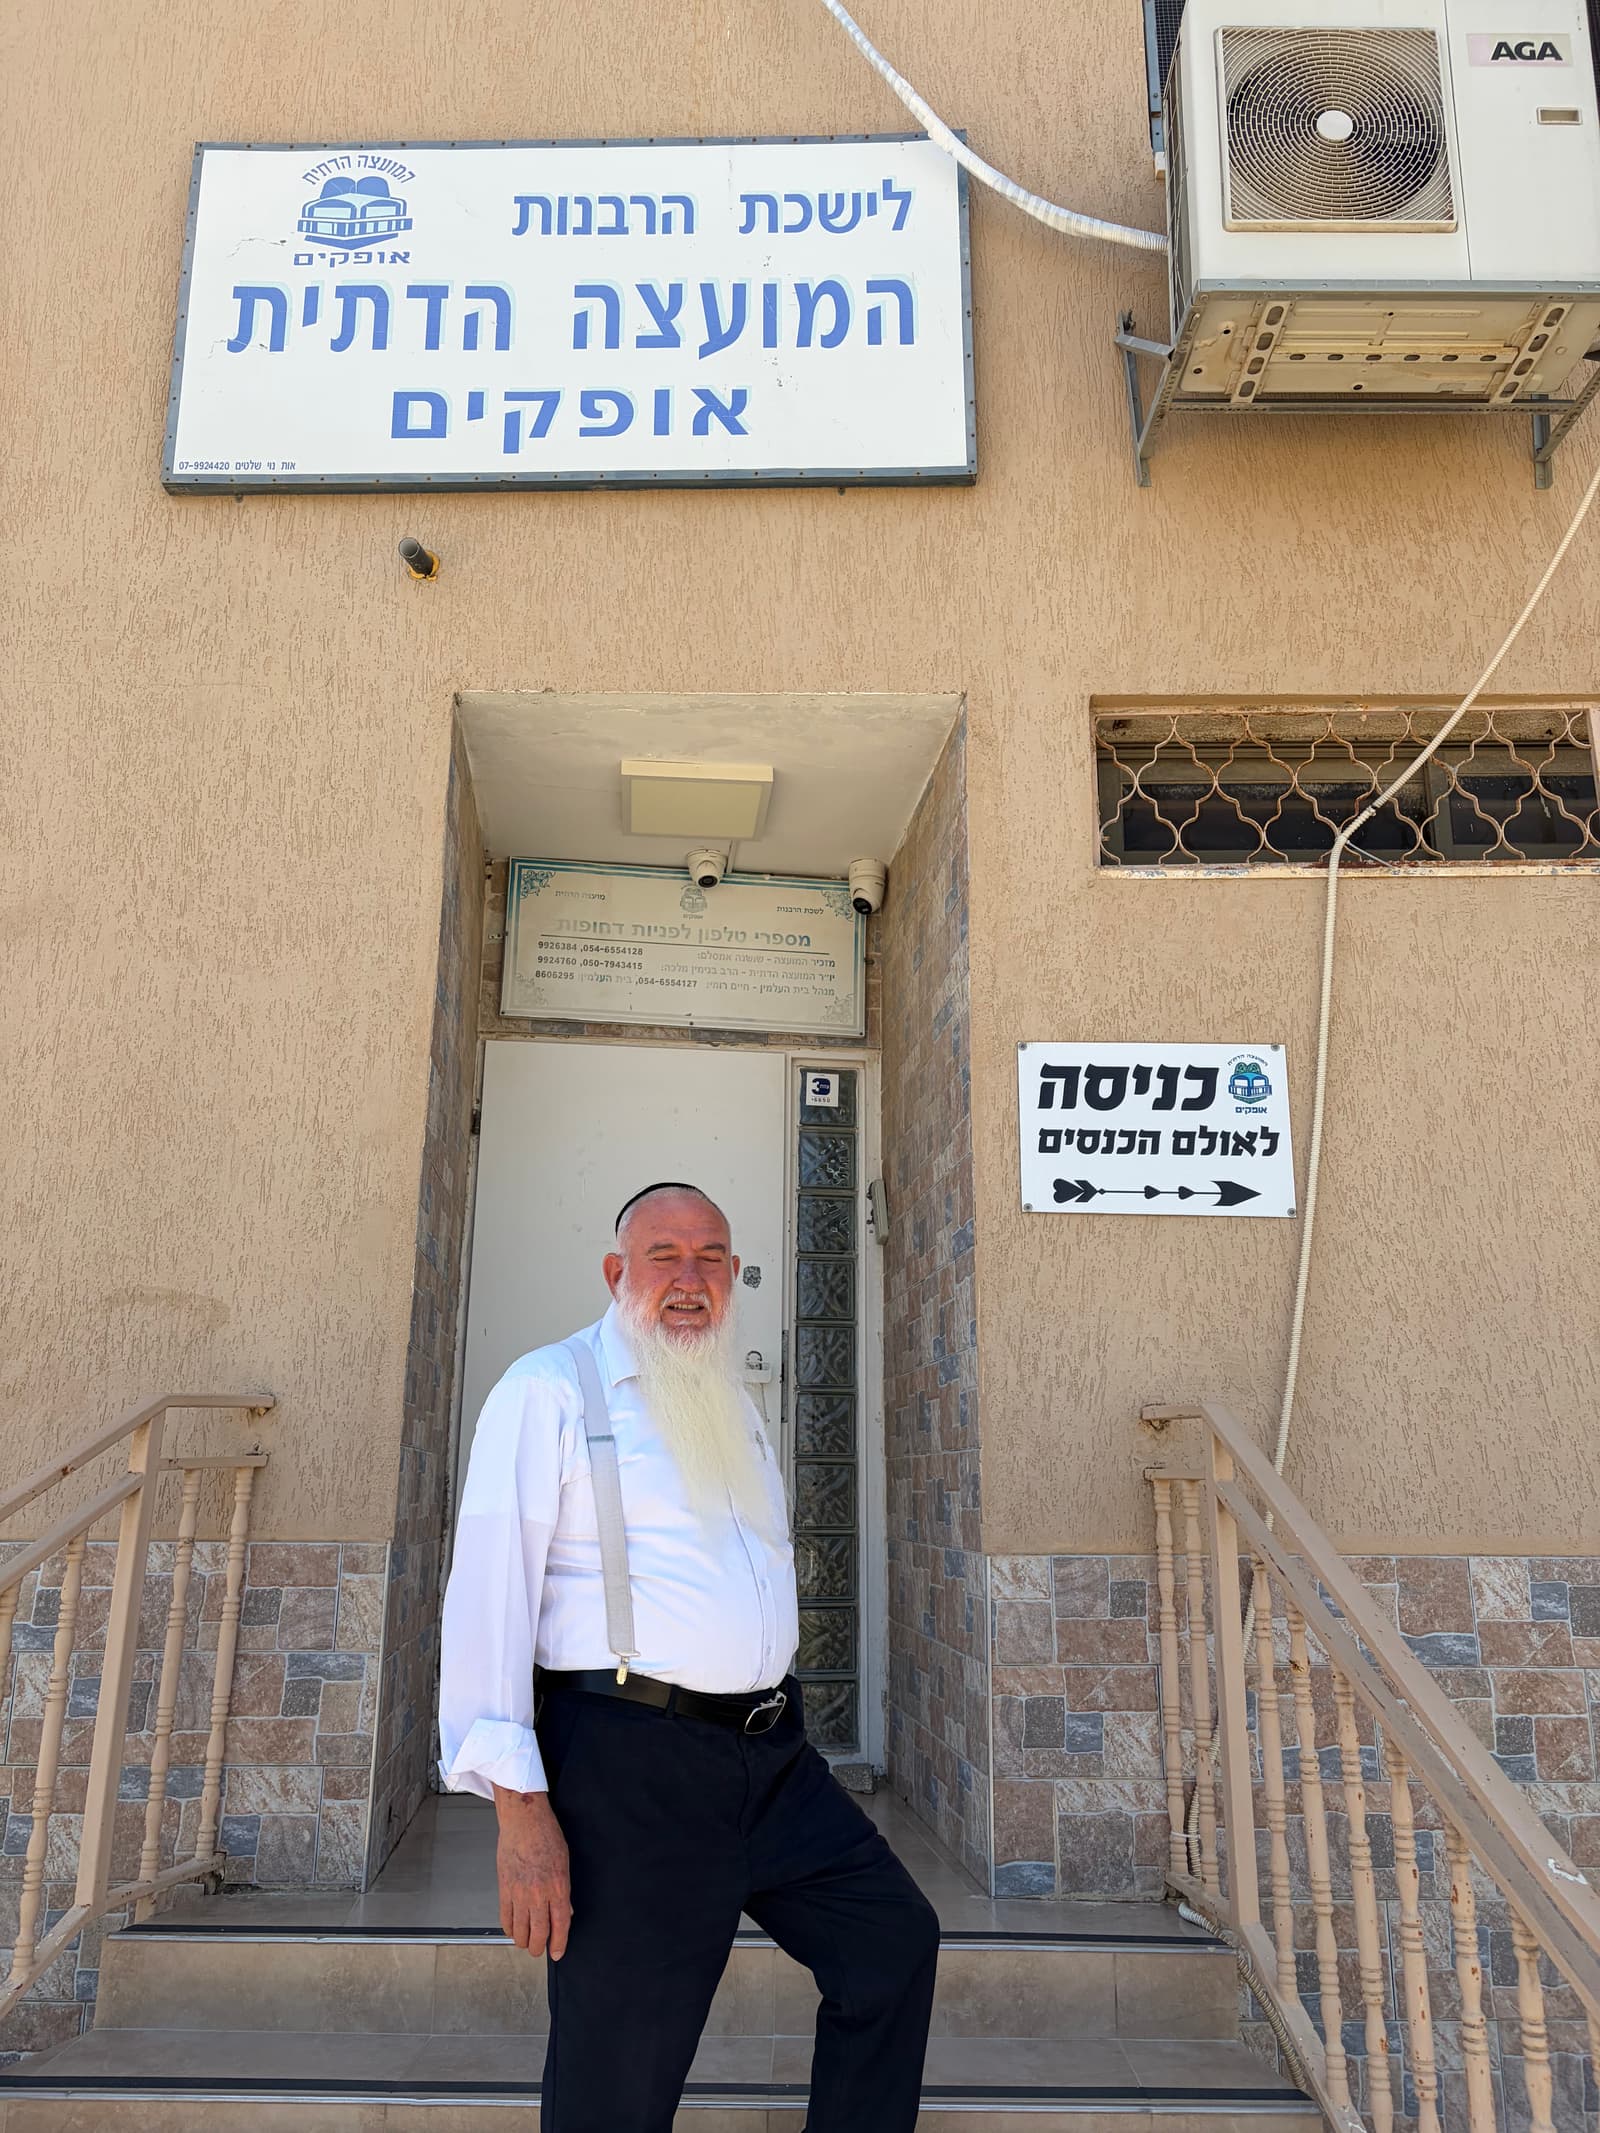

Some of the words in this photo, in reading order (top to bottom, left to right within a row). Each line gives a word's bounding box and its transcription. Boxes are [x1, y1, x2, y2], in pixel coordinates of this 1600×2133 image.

[1491, 41, 1563, 61] AGA
[302, 156, 352, 185] הדתית
[358, 155, 416, 183] המועצה
[512, 194, 696, 236] הרבנות
[739, 179, 913, 234] לישכת
[293, 251, 411, 268] אופקים
[227, 284, 512, 353] הדתית
[573, 279, 916, 360] המועצה
[390, 387, 750, 454] אופקים
[179, 461, 230, 471] 07-9924420
[235, 460, 262, 471] שלטים
[281, 461, 296, 471] אות
[556, 919, 625, 935] דחופות
[631, 923, 692, 940] לפניות
[698, 926, 748, 944] טלפון
[754, 931, 811, 947] מספרי
[774, 956, 808, 966] המועצה
[719, 967, 739, 976] הרב
[781, 971, 816, 980] המועצה
[730, 982, 750, 991] חיים
[759, 982, 790, 995] העלמין
[793, 986, 810, 994] בית
[812, 985, 835, 996] מנהל
[1037, 1062, 1220, 1112] כניסה
[1235, 1106, 1268, 1115] אופקים
[1038, 1127, 1162, 1155] הכנסים
[1172, 1125, 1280, 1157] לאולם
